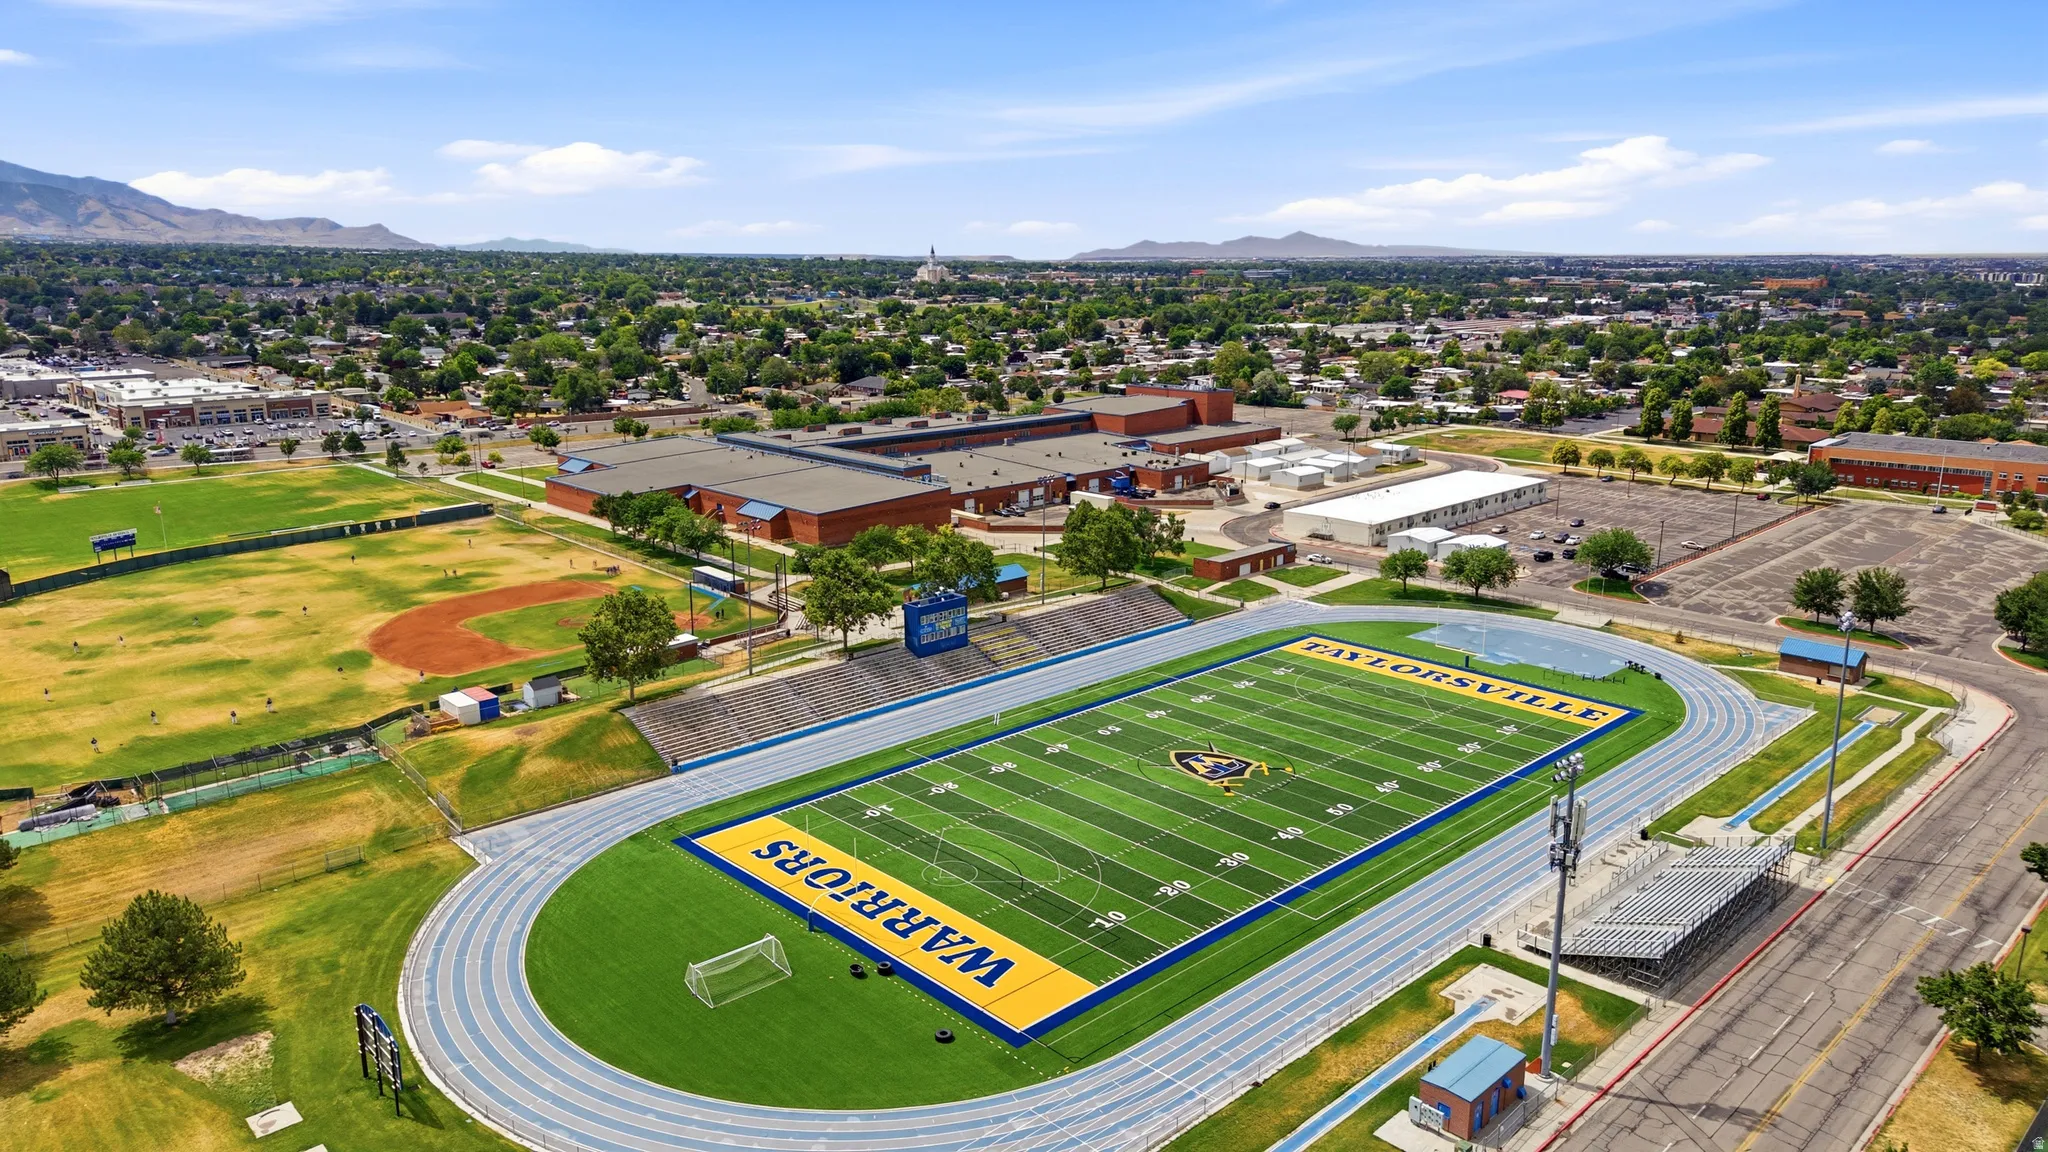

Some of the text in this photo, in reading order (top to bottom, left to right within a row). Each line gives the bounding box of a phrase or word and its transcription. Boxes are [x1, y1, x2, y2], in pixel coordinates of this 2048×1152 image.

[1301, 641, 1609, 721] TAYLORSVILLE
[1098, 725, 1122, 736] 50
[1046, 743, 1069, 753] 40
[991, 762, 1017, 773] 30
[931, 782, 959, 794] 20
[1375, 782, 1399, 792] 40
[866, 805, 894, 817] 10
[1325, 803, 1354, 816] 50
[1277, 827, 1304, 840] 40
[1219, 852, 1250, 867] 30
[1159, 880, 1191, 897] 20
[751, 839, 1016, 989] WARRIORS
[1094, 911, 1127, 928] 10
